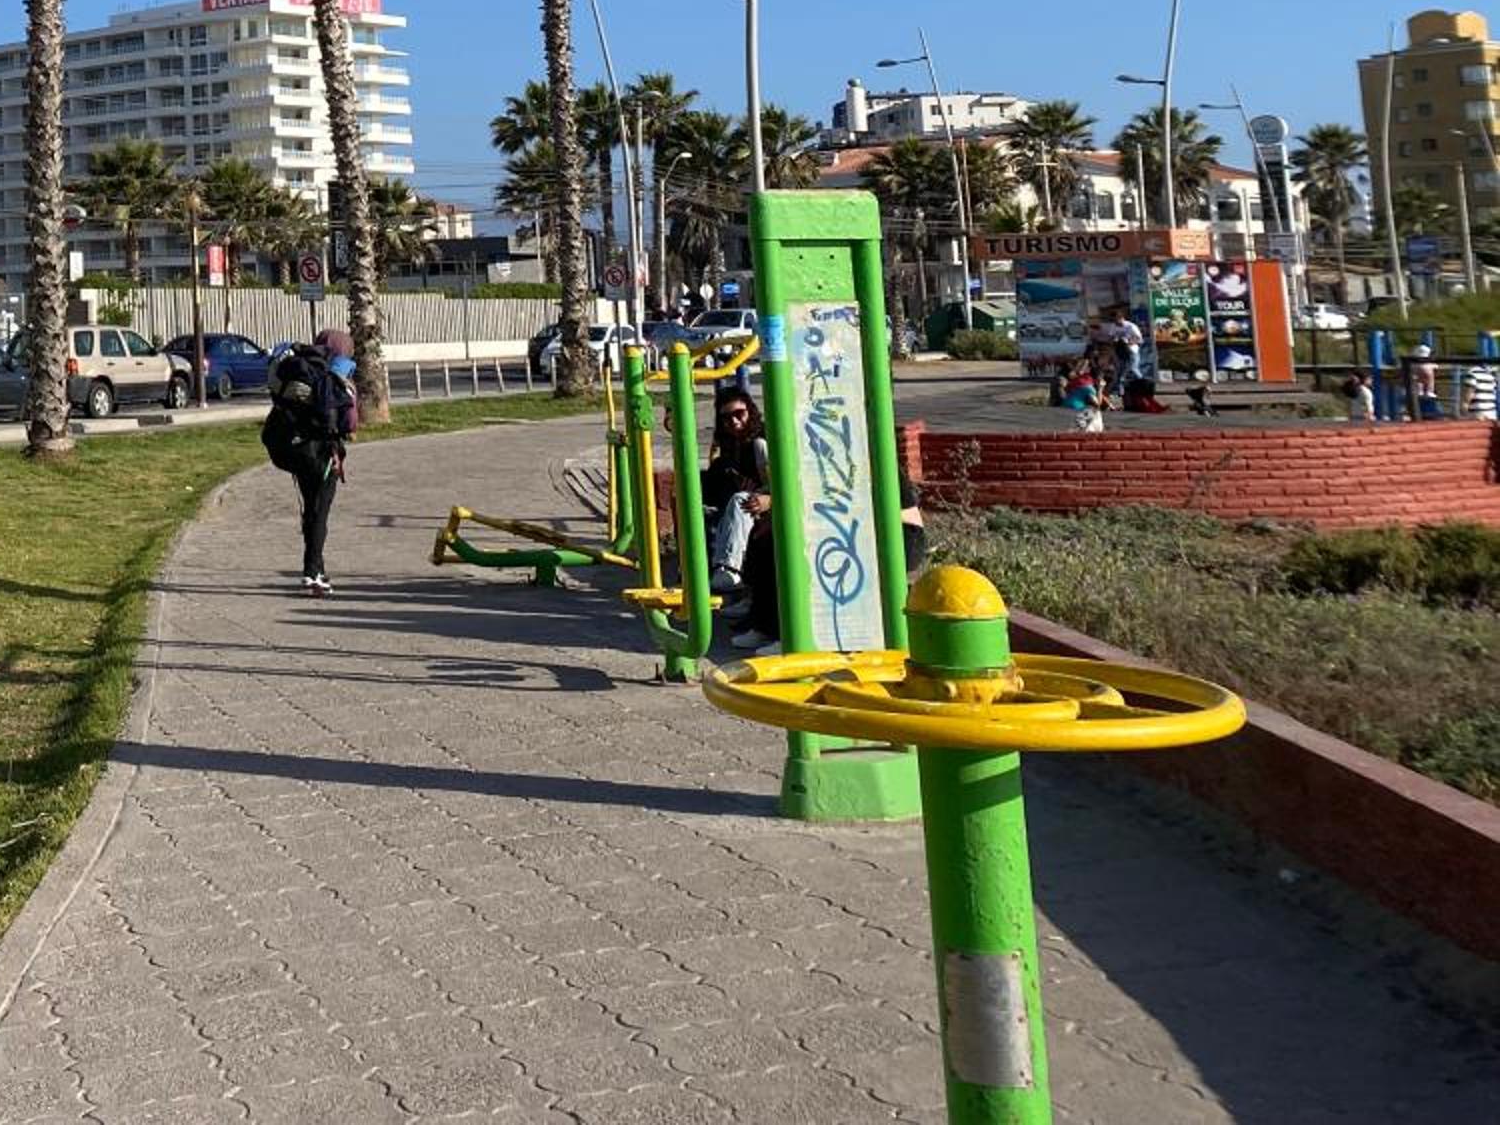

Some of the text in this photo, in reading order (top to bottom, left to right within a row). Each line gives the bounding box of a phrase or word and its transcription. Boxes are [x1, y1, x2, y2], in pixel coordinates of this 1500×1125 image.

[985, 234, 1121, 254] TURISMO
[1162, 288, 1190, 297] VALLE
[1155, 297, 1200, 308] DE ELQUI
